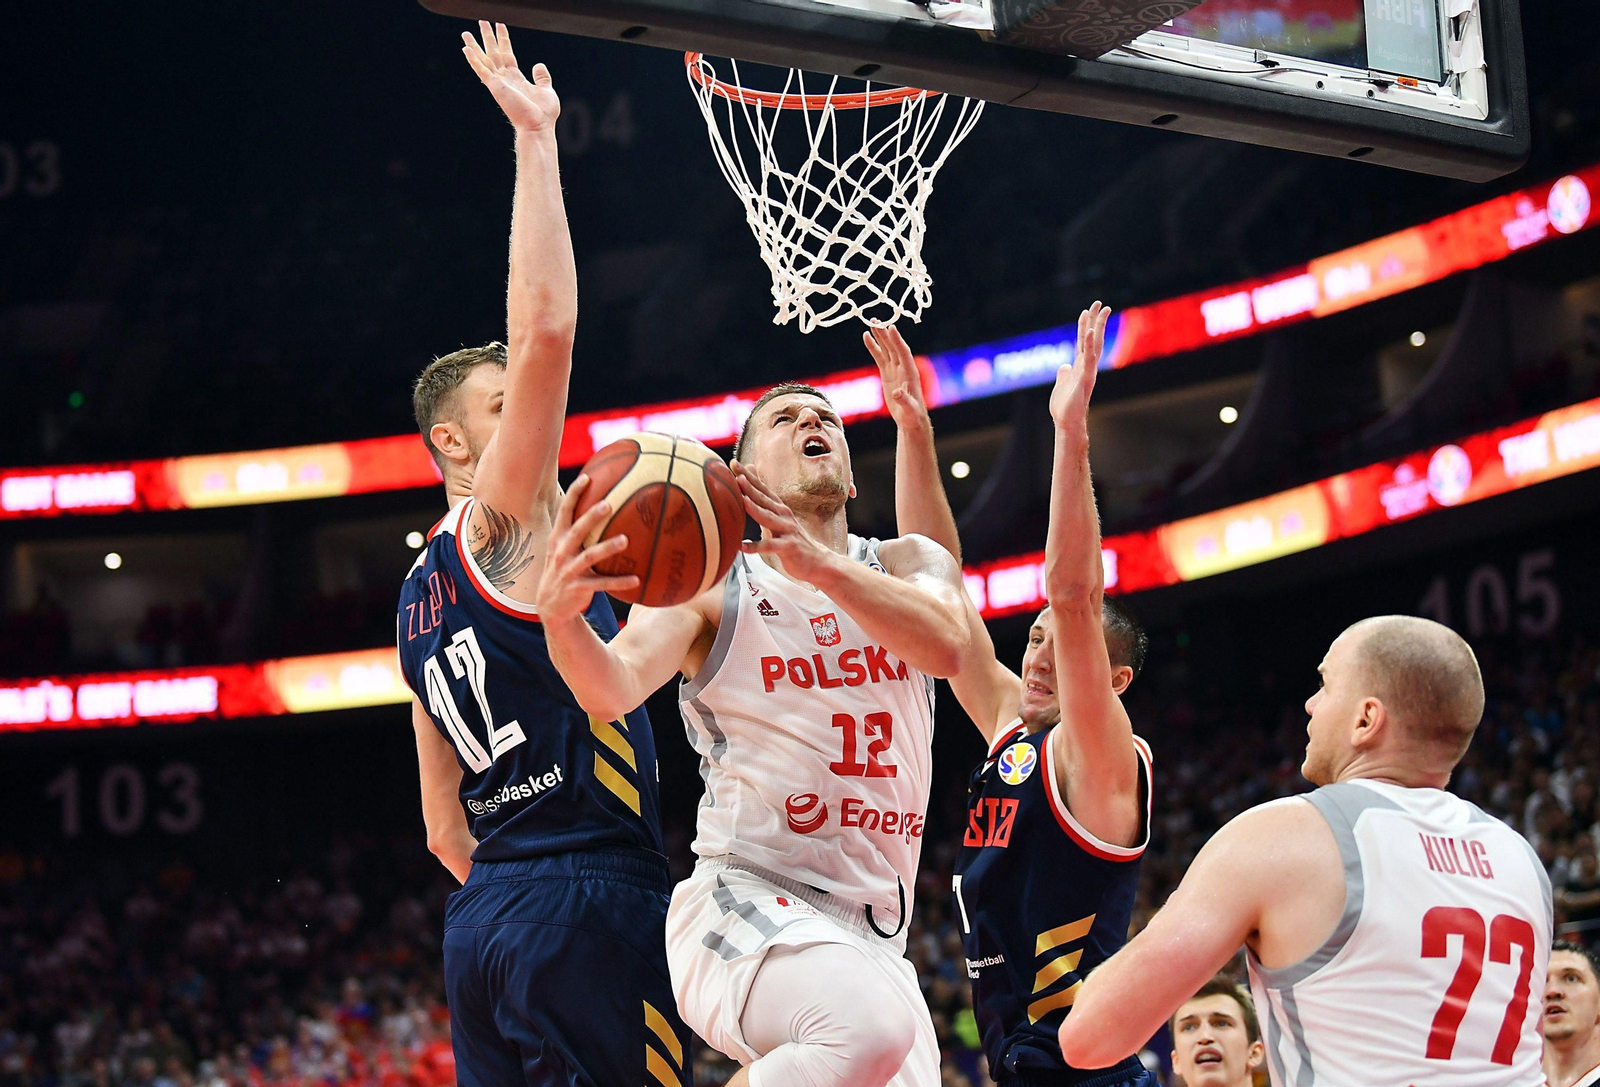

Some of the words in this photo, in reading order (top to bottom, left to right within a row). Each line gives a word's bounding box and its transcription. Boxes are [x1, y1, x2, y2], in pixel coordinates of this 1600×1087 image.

[1418, 549, 1561, 637] 105
[423, 625, 528, 775] 12
[828, 711, 898, 779] 12
[45, 761, 205, 837] 103
[1418, 832, 1495, 880] KULIG
[1419, 905, 1536, 1067] 77
